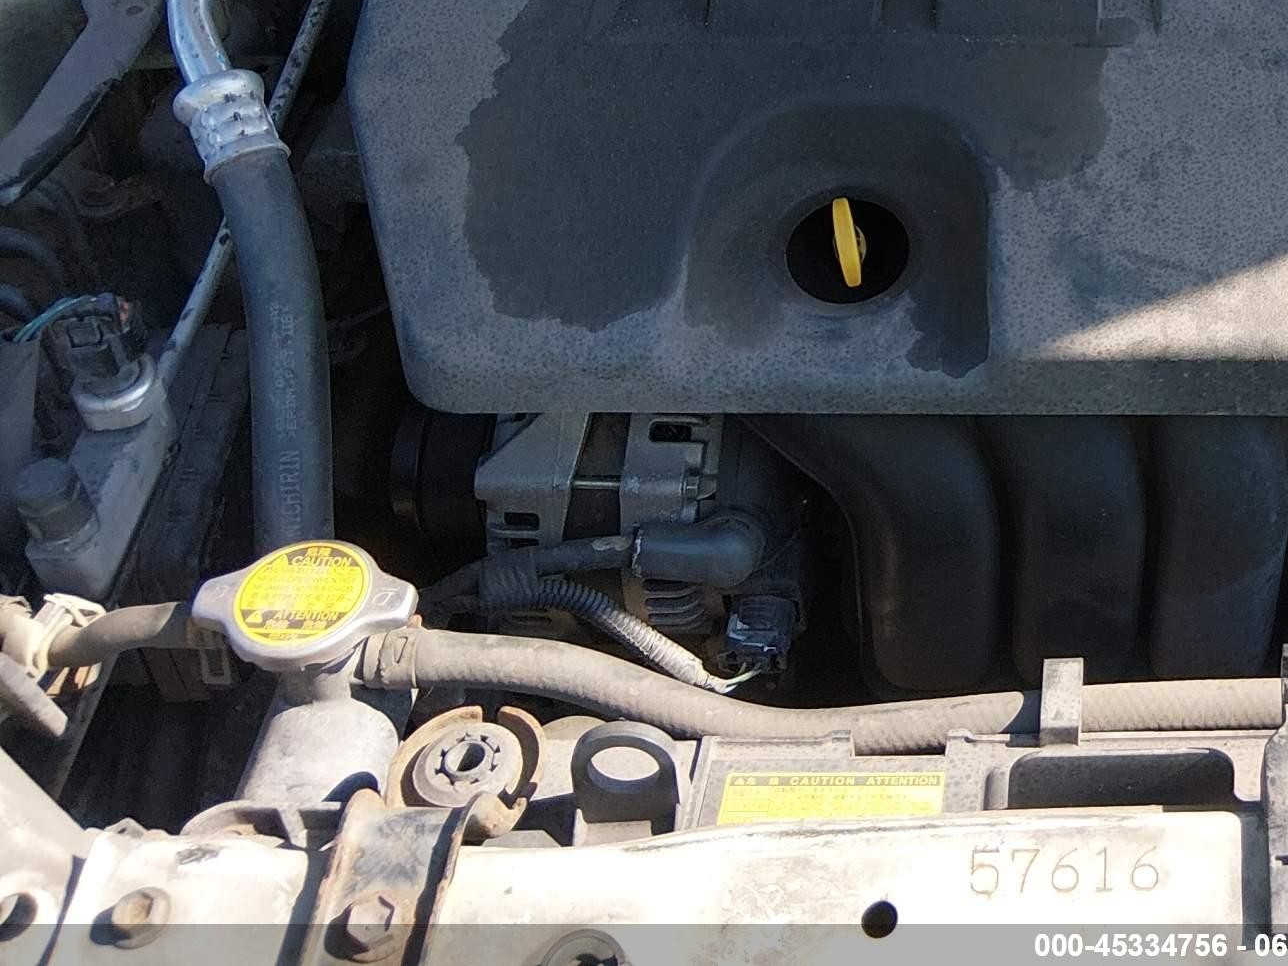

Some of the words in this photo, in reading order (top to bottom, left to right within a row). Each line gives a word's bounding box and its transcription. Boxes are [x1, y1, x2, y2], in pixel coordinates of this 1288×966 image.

[292, 556, 352, 566] CAUTION
[274, 610, 338, 621] ATTENTION
[789, 775, 855, 786] CAUTION
[865, 775, 939, 786] ATTENTION
[969, 844, 1160, 896] 57616
